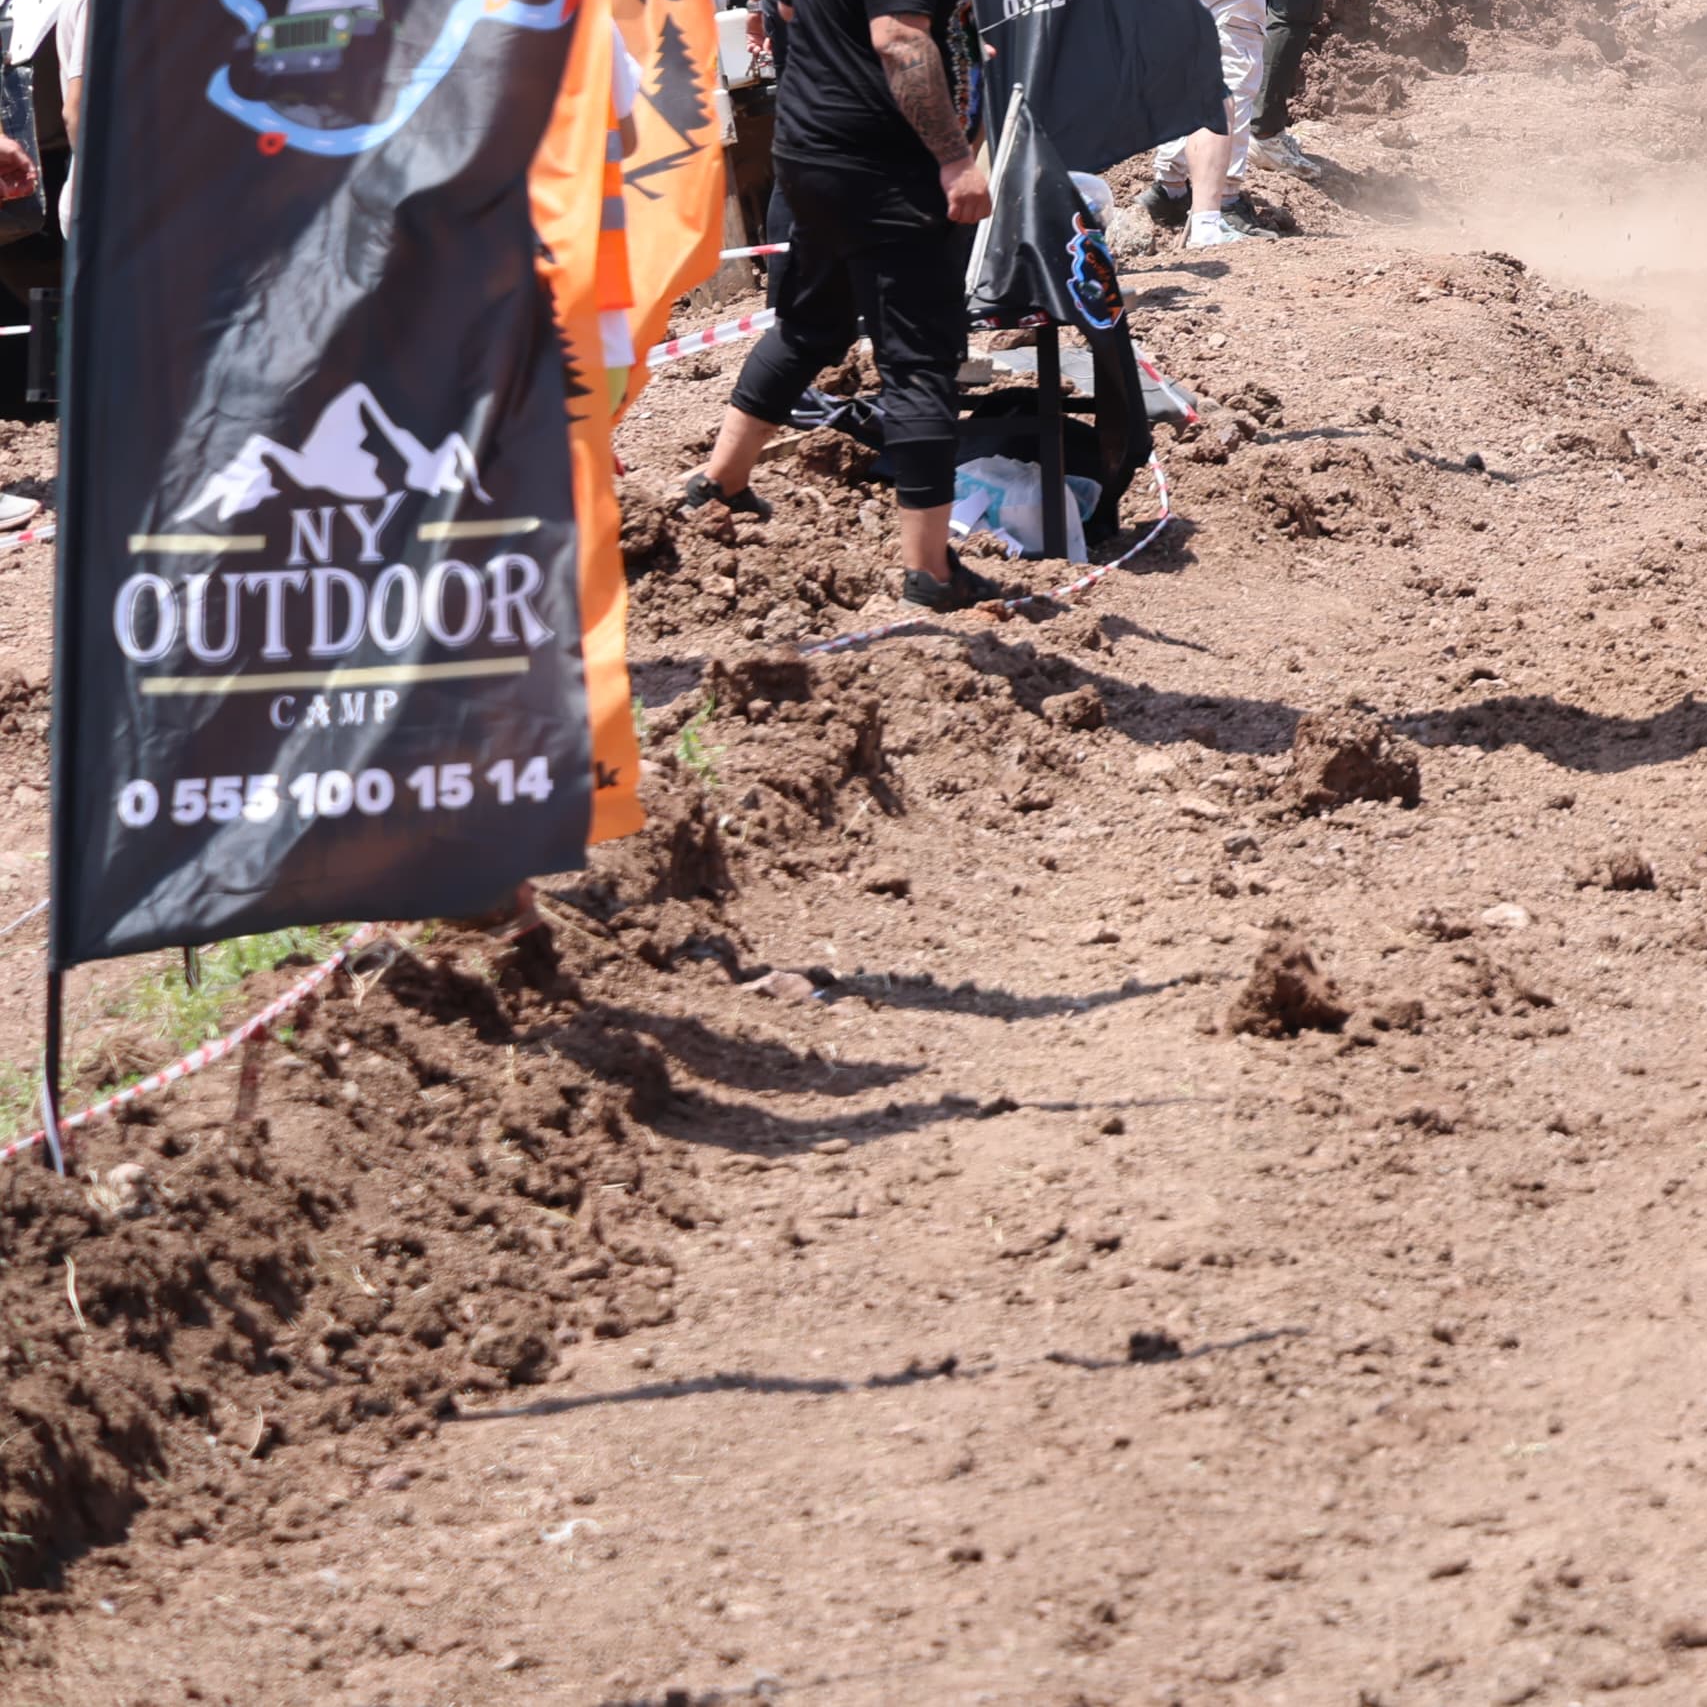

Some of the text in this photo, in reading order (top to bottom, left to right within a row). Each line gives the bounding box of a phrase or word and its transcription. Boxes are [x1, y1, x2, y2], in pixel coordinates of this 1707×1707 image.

[287, 490, 407, 565] NY
[113, 552, 556, 664] OUTDOOR
[269, 689, 401, 730] CAMP
[117, 779, 159, 829] 0
[171, 773, 281, 826] 555
[288, 767, 395, 819] 100
[406, 762, 475, 811] 15
[484, 755, 554, 805] 14
